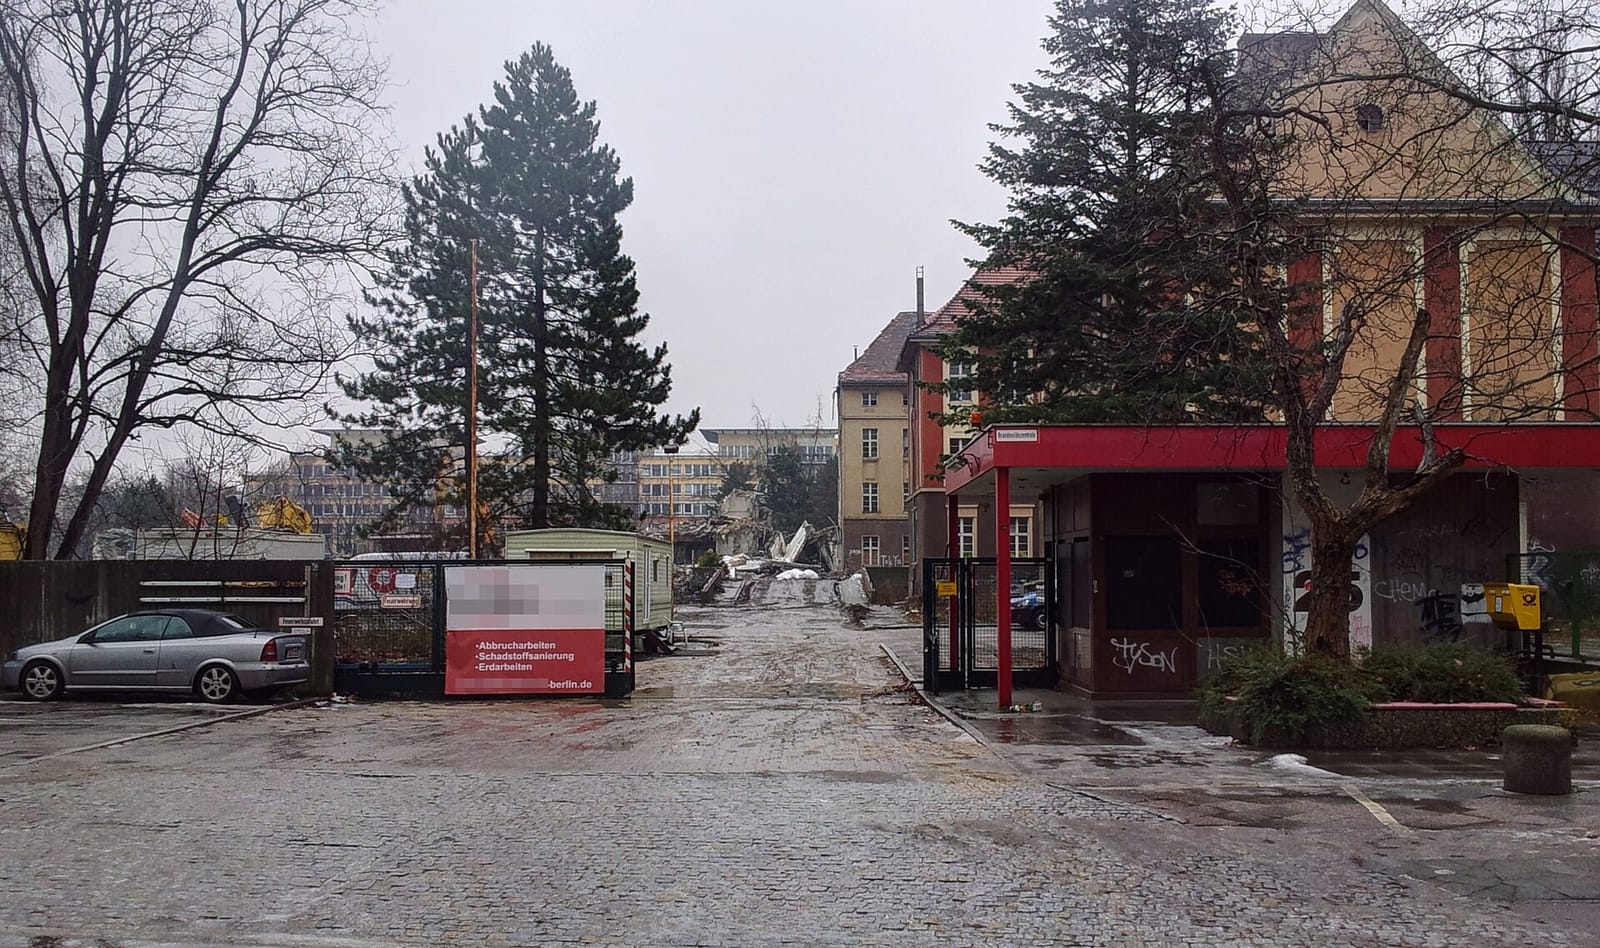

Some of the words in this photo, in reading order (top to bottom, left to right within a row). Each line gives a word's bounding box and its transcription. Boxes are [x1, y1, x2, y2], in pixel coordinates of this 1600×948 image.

[478, 641, 556, 650] Abbrucharbeiten
[478, 652, 575, 661] Schadstoffsanierung
[478, 663, 533, 671] Erdarbeiten
[547, 680, 593, 689] -berlin.de
